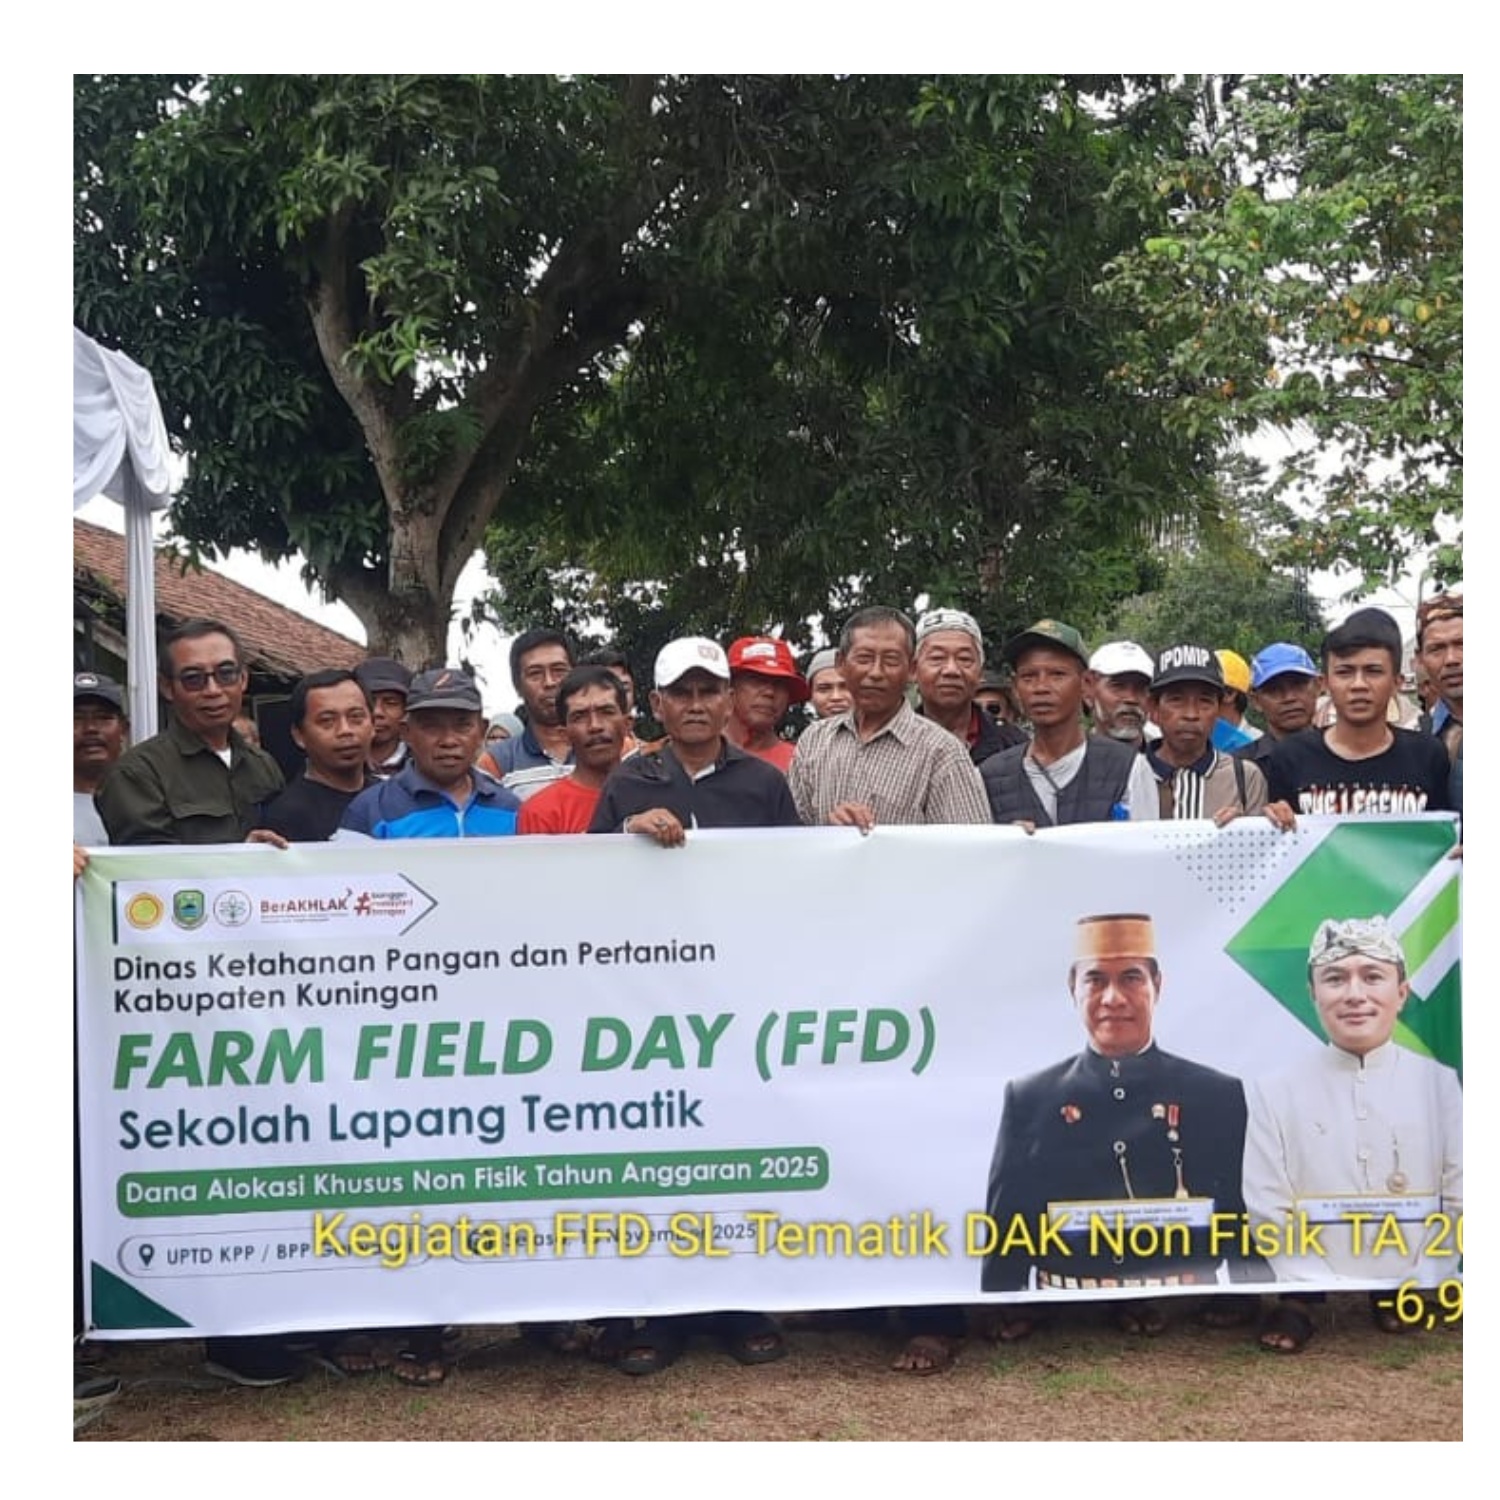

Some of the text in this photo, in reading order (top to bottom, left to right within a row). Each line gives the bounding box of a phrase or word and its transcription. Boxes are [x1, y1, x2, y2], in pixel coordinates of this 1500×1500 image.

[113, 939, 716, 981] Dinas Ketahanan Pangan dan Pertanian
[114, 980, 438, 1016] Kabupaten Kuningan
[112, 1005, 936, 1091] FARM FIELD DAY (FFD)
[119, 1090, 704, 1151] Sekolah Lapang Tematik
[126, 1156, 820, 1203] Dana Alokasi Khusus Non Fisik Tahun Anggaran 2025
[713, 1222, 756, 1241] 2025
[166, 1247, 212, 1266] UPTD
[220, 1244, 255, 1262] KPP
[261, 1243, 270, 1263] /
[276, 1243, 309, 1260] BPP
